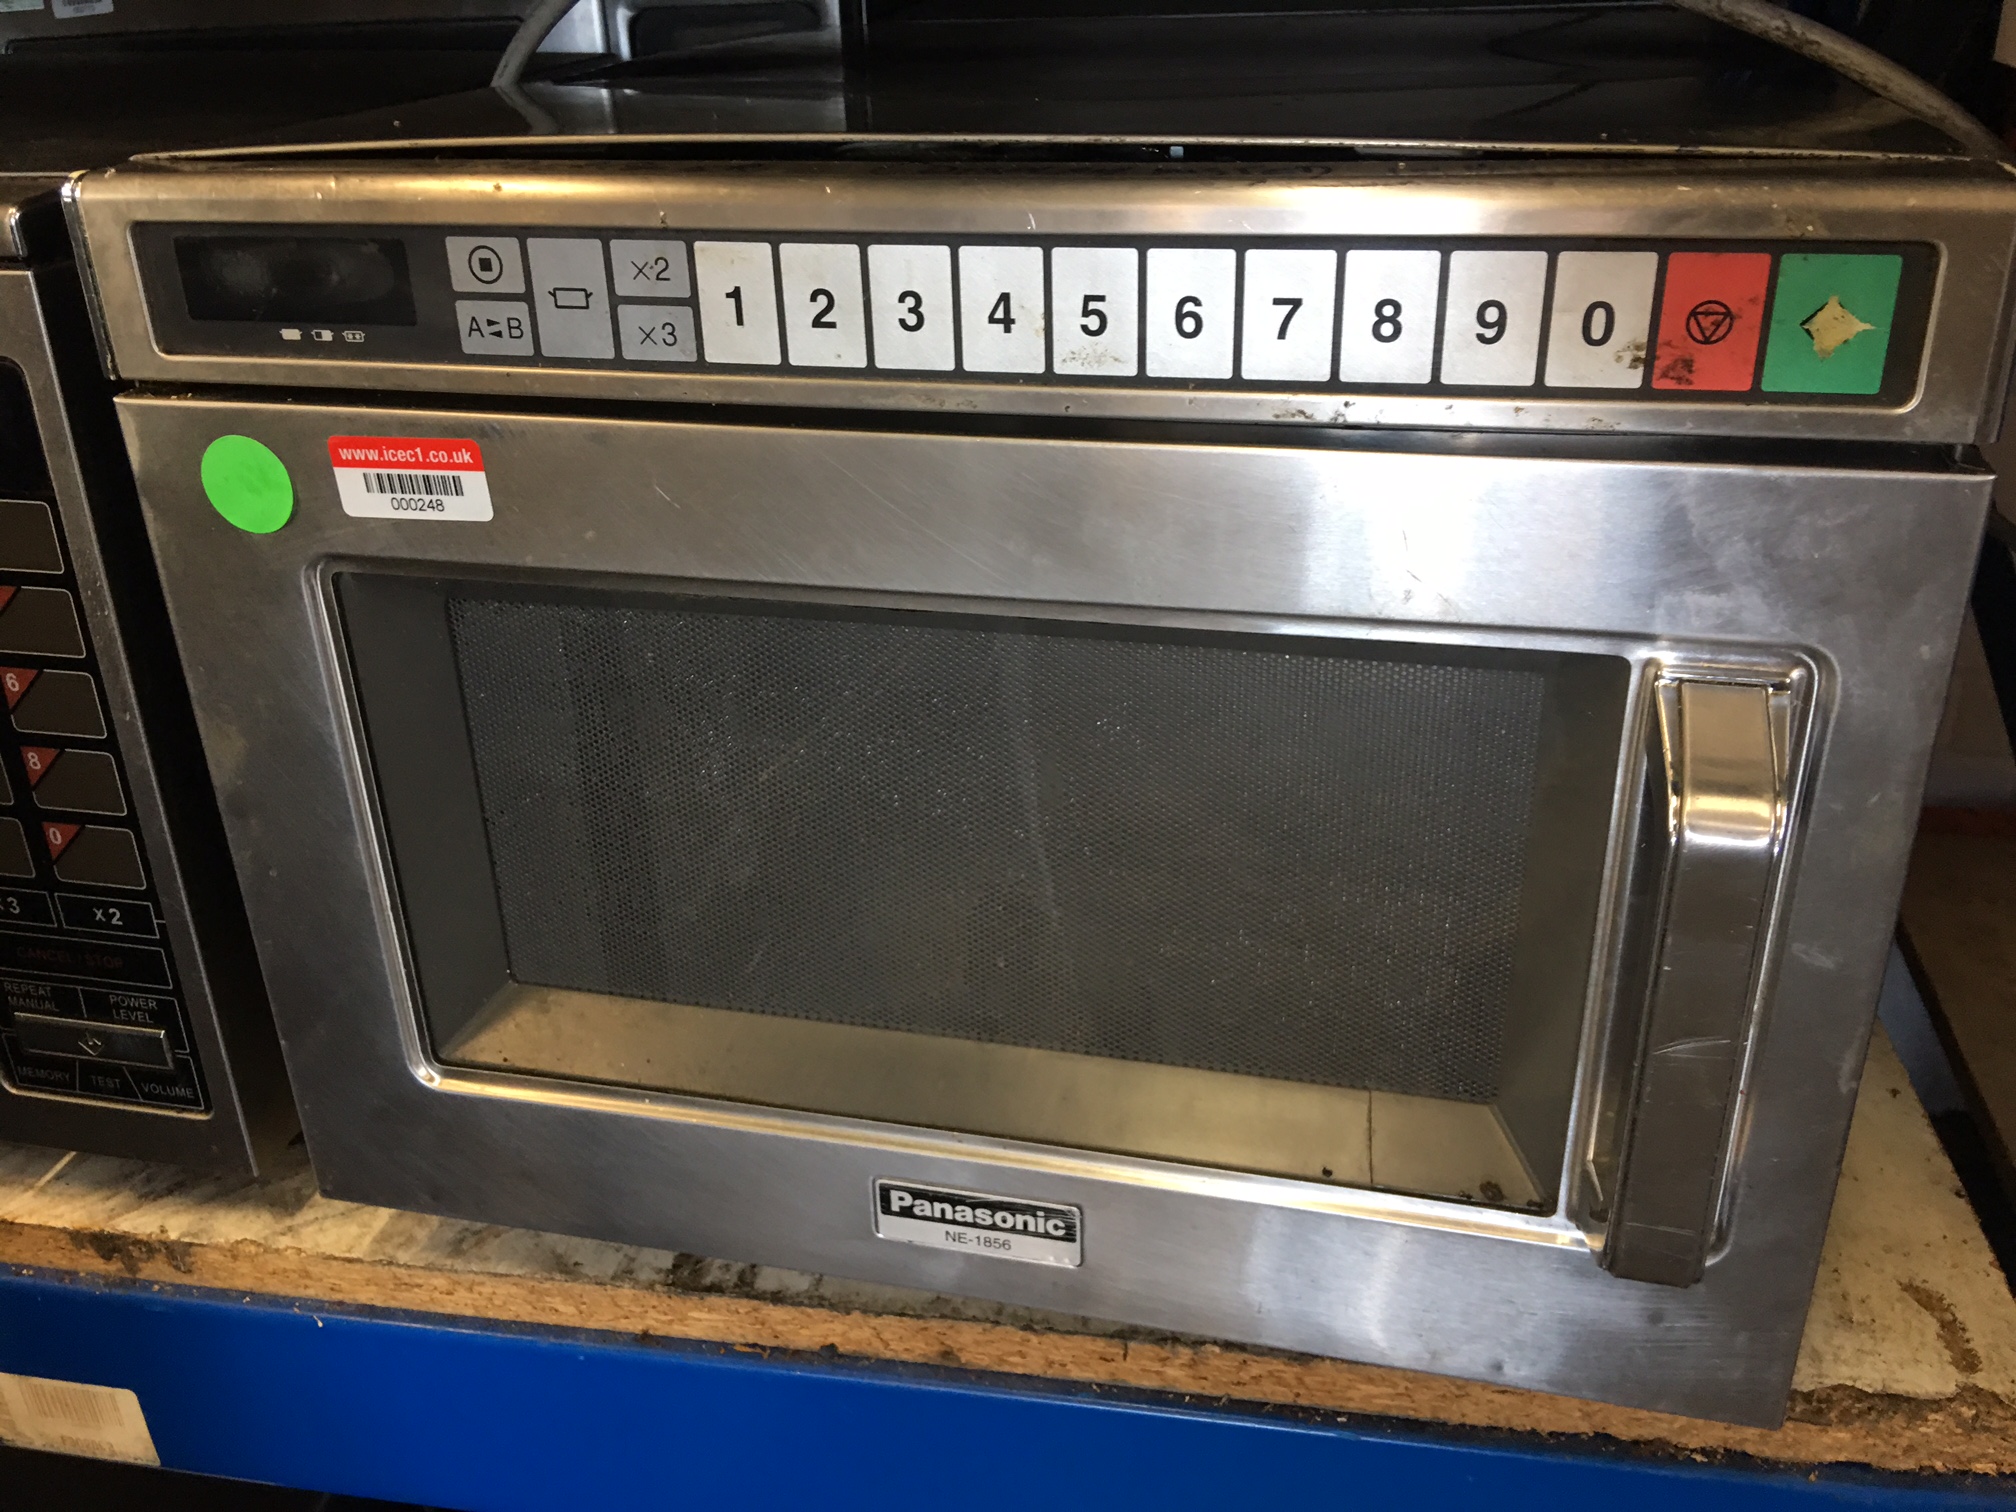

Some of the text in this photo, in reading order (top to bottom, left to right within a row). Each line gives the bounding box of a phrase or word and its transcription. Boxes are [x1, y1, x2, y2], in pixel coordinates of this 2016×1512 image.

[725, 285, 1616, 347] 1 2 3 4 5 6 7 8 9 0
[338, 446, 474, 464] www.icec1.co.uk
[390, 496, 445, 512] 000248
[5, 672, 20, 693] 6
[26, 751, 42, 771] 8
[49, 827, 63, 846] 0
[3, 982, 51, 998] REPEAT
[7, 996, 60, 1012] MANUAL
[109, 994, 158, 1010] POWER
[113, 1010, 153, 1024] LEVEL
[18, 1065, 71, 1082] MEMORY
[90, 1075, 121, 1089] TEST
[141, 1082, 195, 1099] VOLUME
[889, 1189, 1066, 1237] Panasonic
[945, 1229, 1012, 1251] NE-1856
